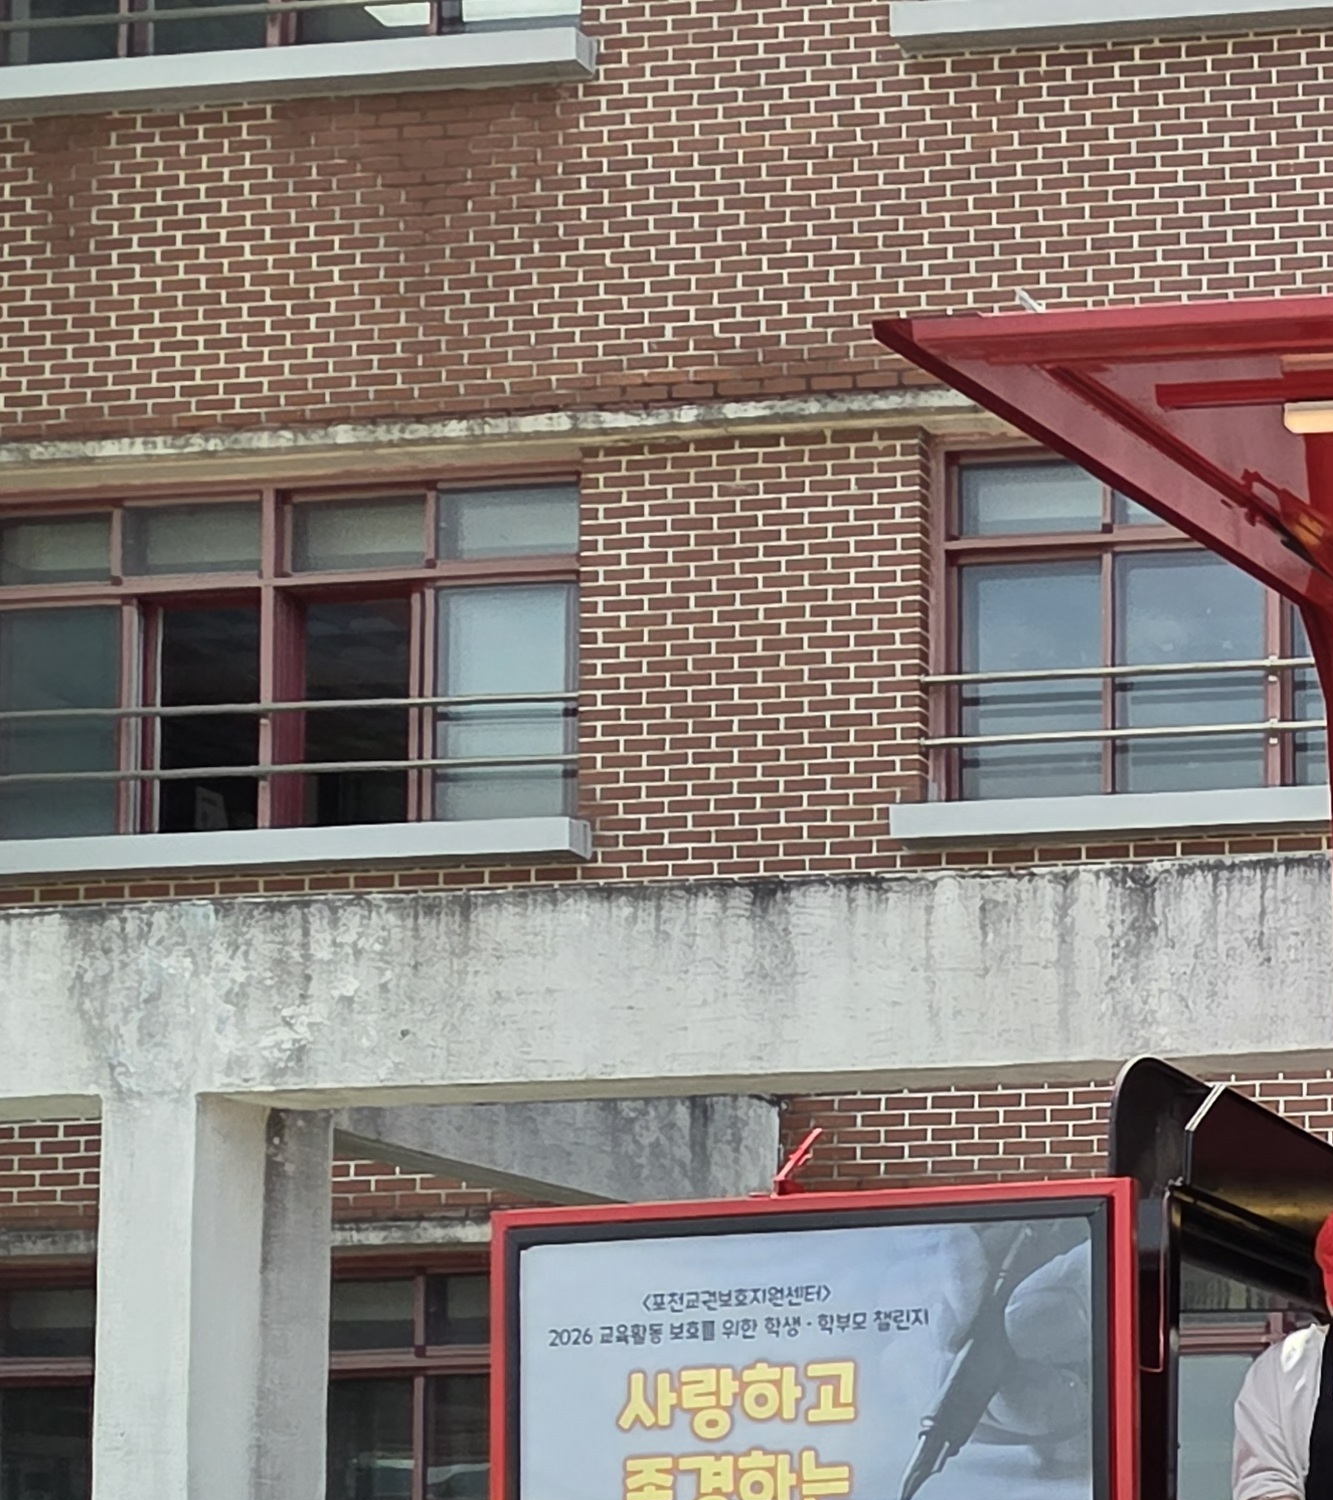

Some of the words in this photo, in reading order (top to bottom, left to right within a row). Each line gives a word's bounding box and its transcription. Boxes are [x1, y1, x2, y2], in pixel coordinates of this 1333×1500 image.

[548, 1328, 593, 1348] 2026
[599, 1323, 663, 1346] 교육활동
[670, 1320, 715, 1342] 보호를
[722, 1317, 758, 1340] 위한
[764, 1314, 801, 1339] 학생
[818, 1311, 868, 1334] 학부모
[873, 1307, 930, 1333] 챌린지
[617, 1361, 856, 1440] 사랑하고
